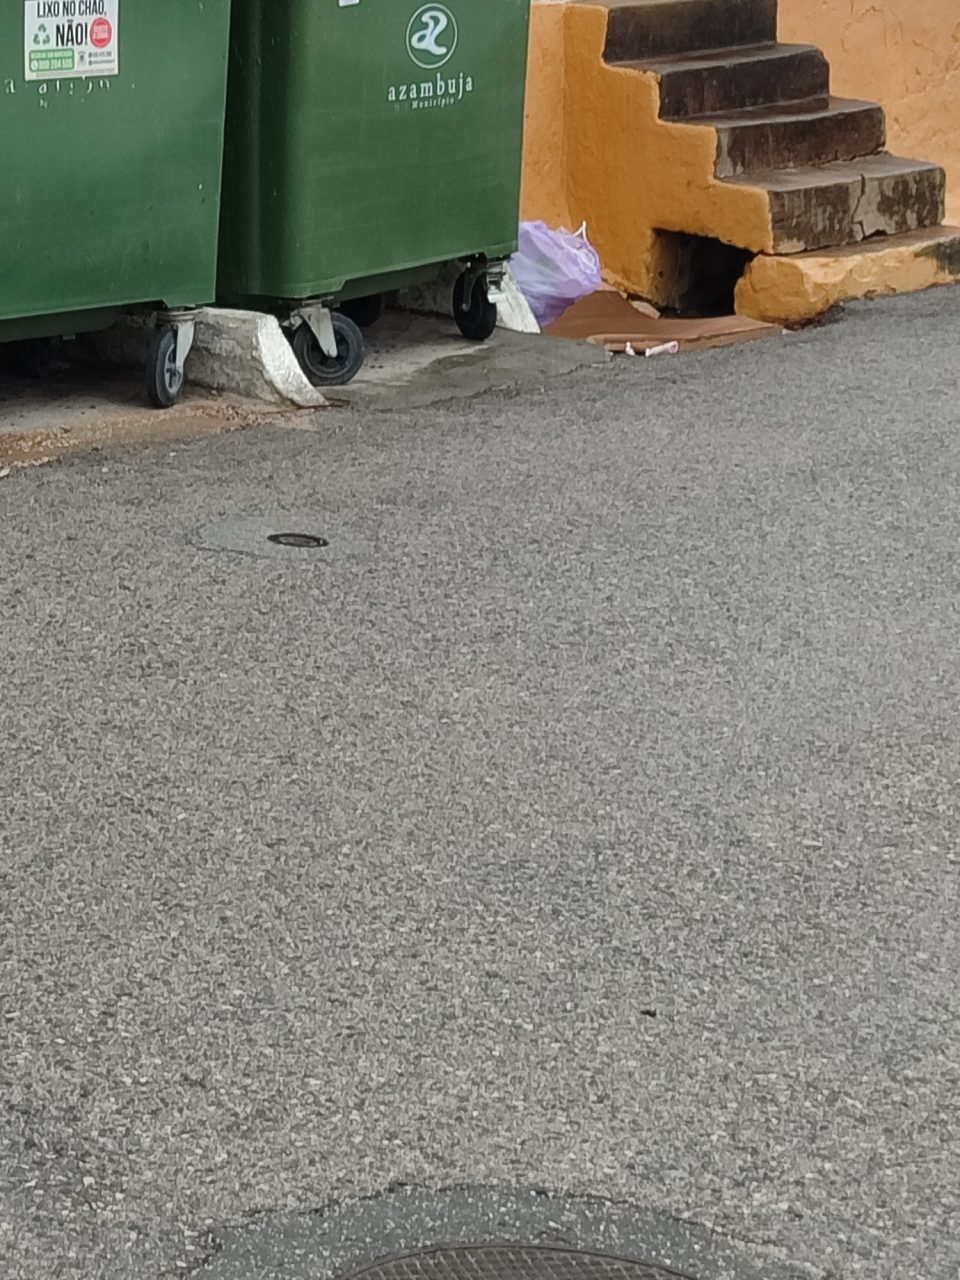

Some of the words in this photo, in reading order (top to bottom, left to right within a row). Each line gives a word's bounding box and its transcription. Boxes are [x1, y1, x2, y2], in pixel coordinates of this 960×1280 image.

[37, 0, 60, 19] LIXO
[62, 0, 76, 17] NO
[55, 19, 88, 47] NÃO!
[387, 72, 473, 102] azambuja
